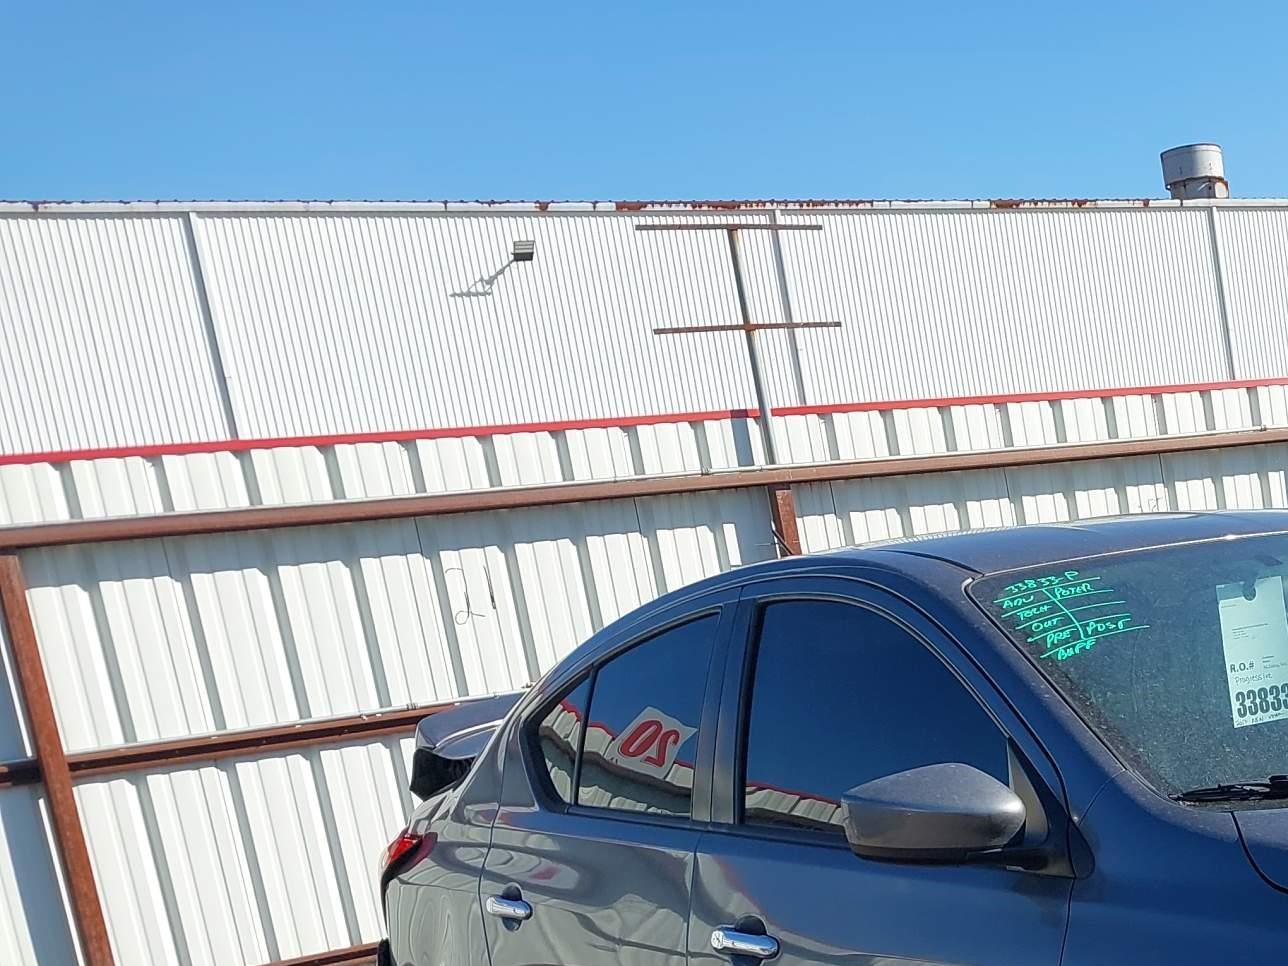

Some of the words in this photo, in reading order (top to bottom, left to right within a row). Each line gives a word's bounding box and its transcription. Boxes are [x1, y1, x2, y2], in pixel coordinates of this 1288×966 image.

[1032, 616, 1064, 632] OUT
[1086, 618, 1131, 635] POST
[1047, 628, 1077, 648] PRE
